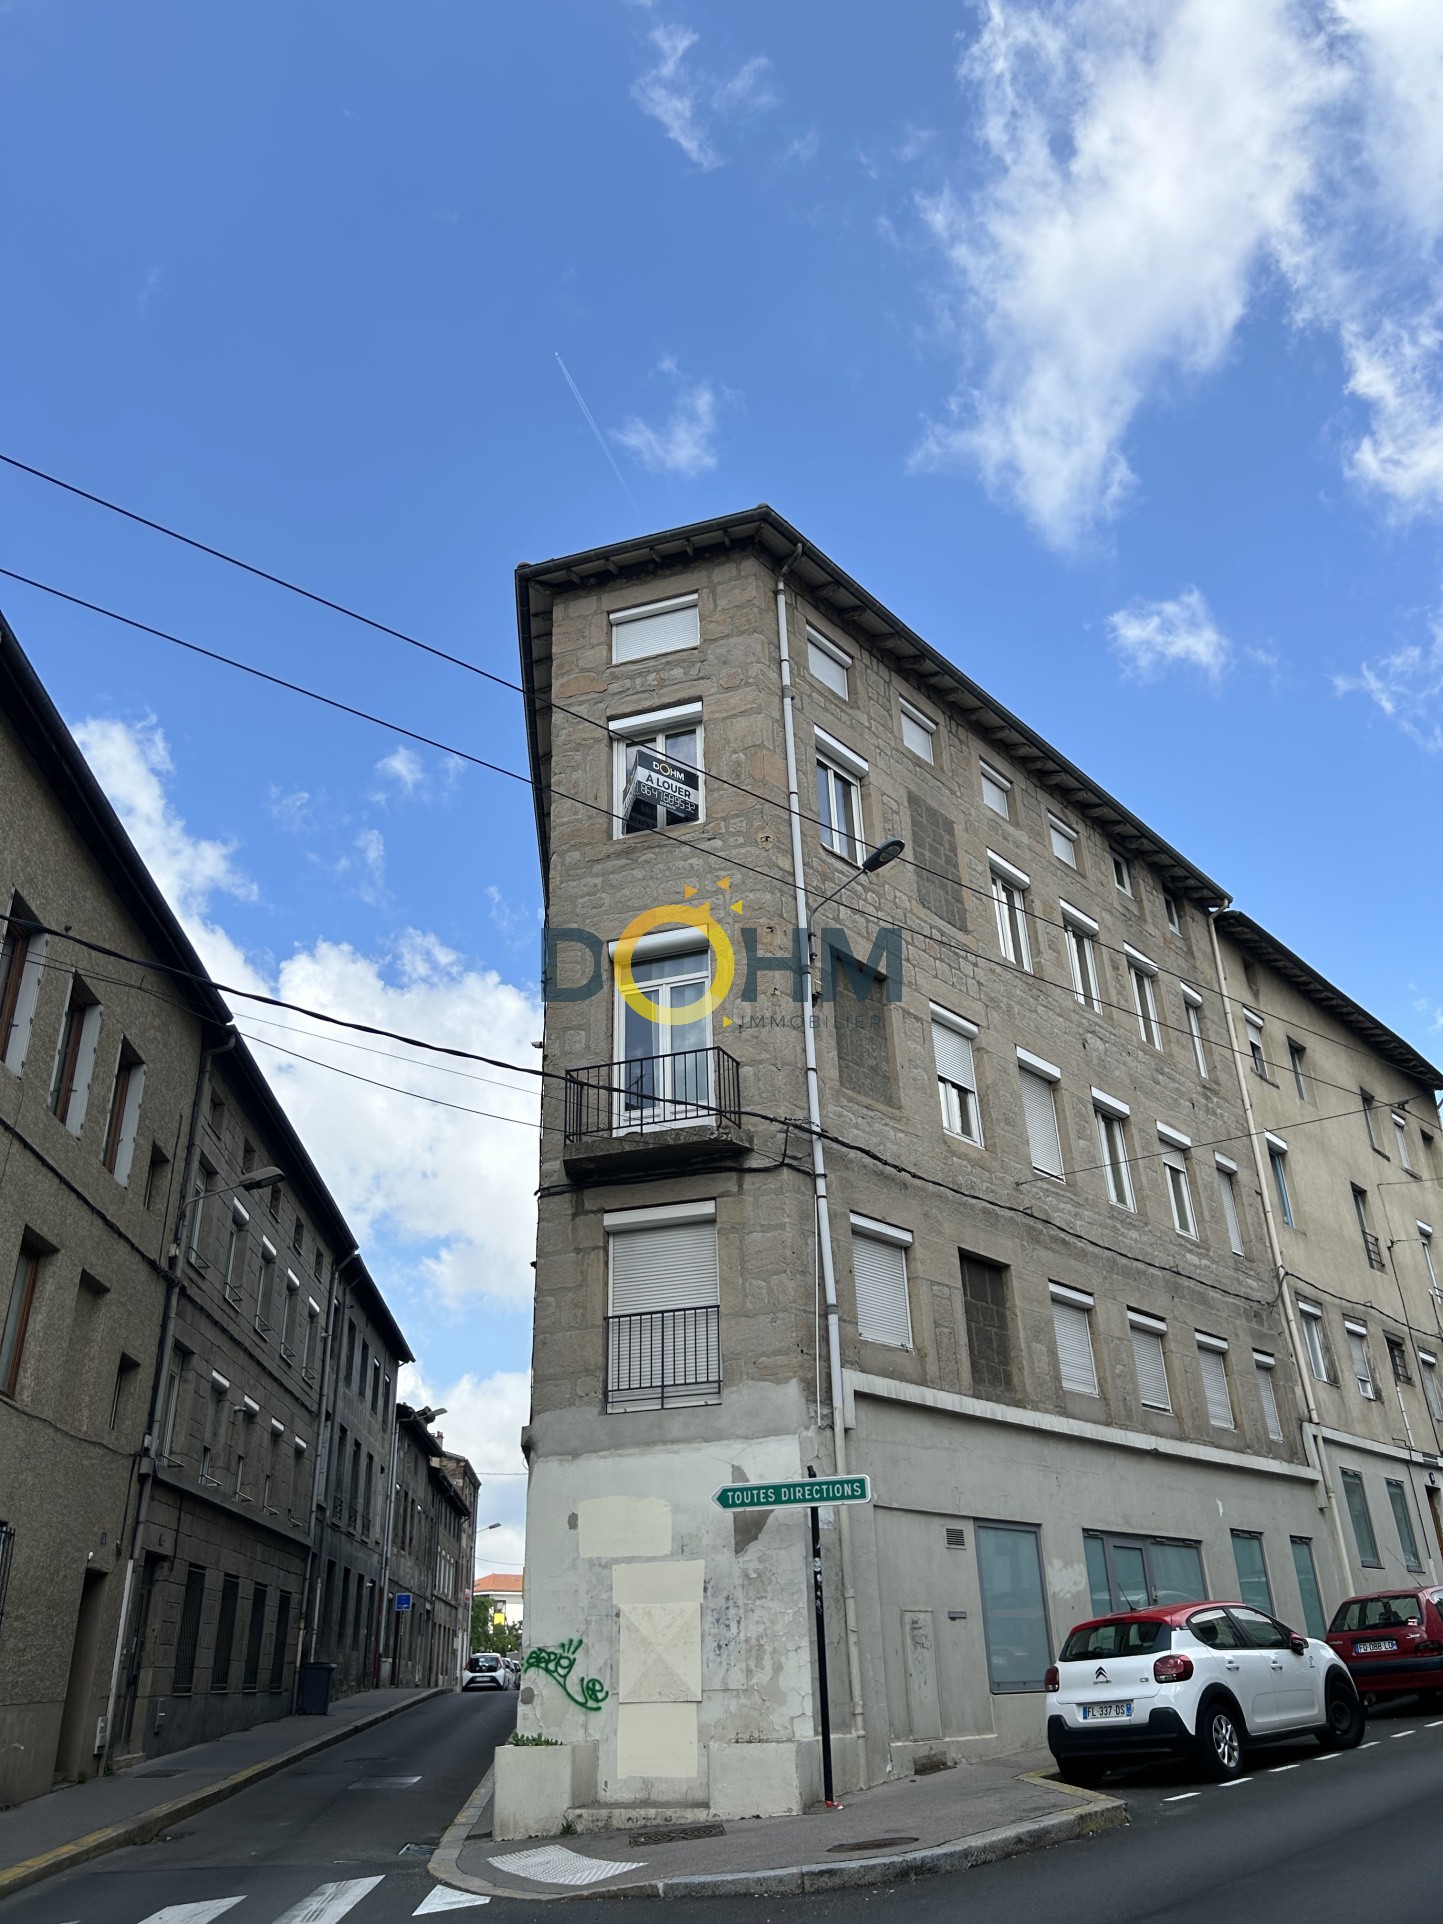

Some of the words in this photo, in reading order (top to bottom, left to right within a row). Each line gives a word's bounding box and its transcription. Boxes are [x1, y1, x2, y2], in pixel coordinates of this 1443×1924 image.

[645, 771, 654, 785] À
[656, 777, 691, 799] LOUER
[727, 1489, 775, 1505] TOUTES
[781, 1482, 862, 1500] DIRECTIONS
